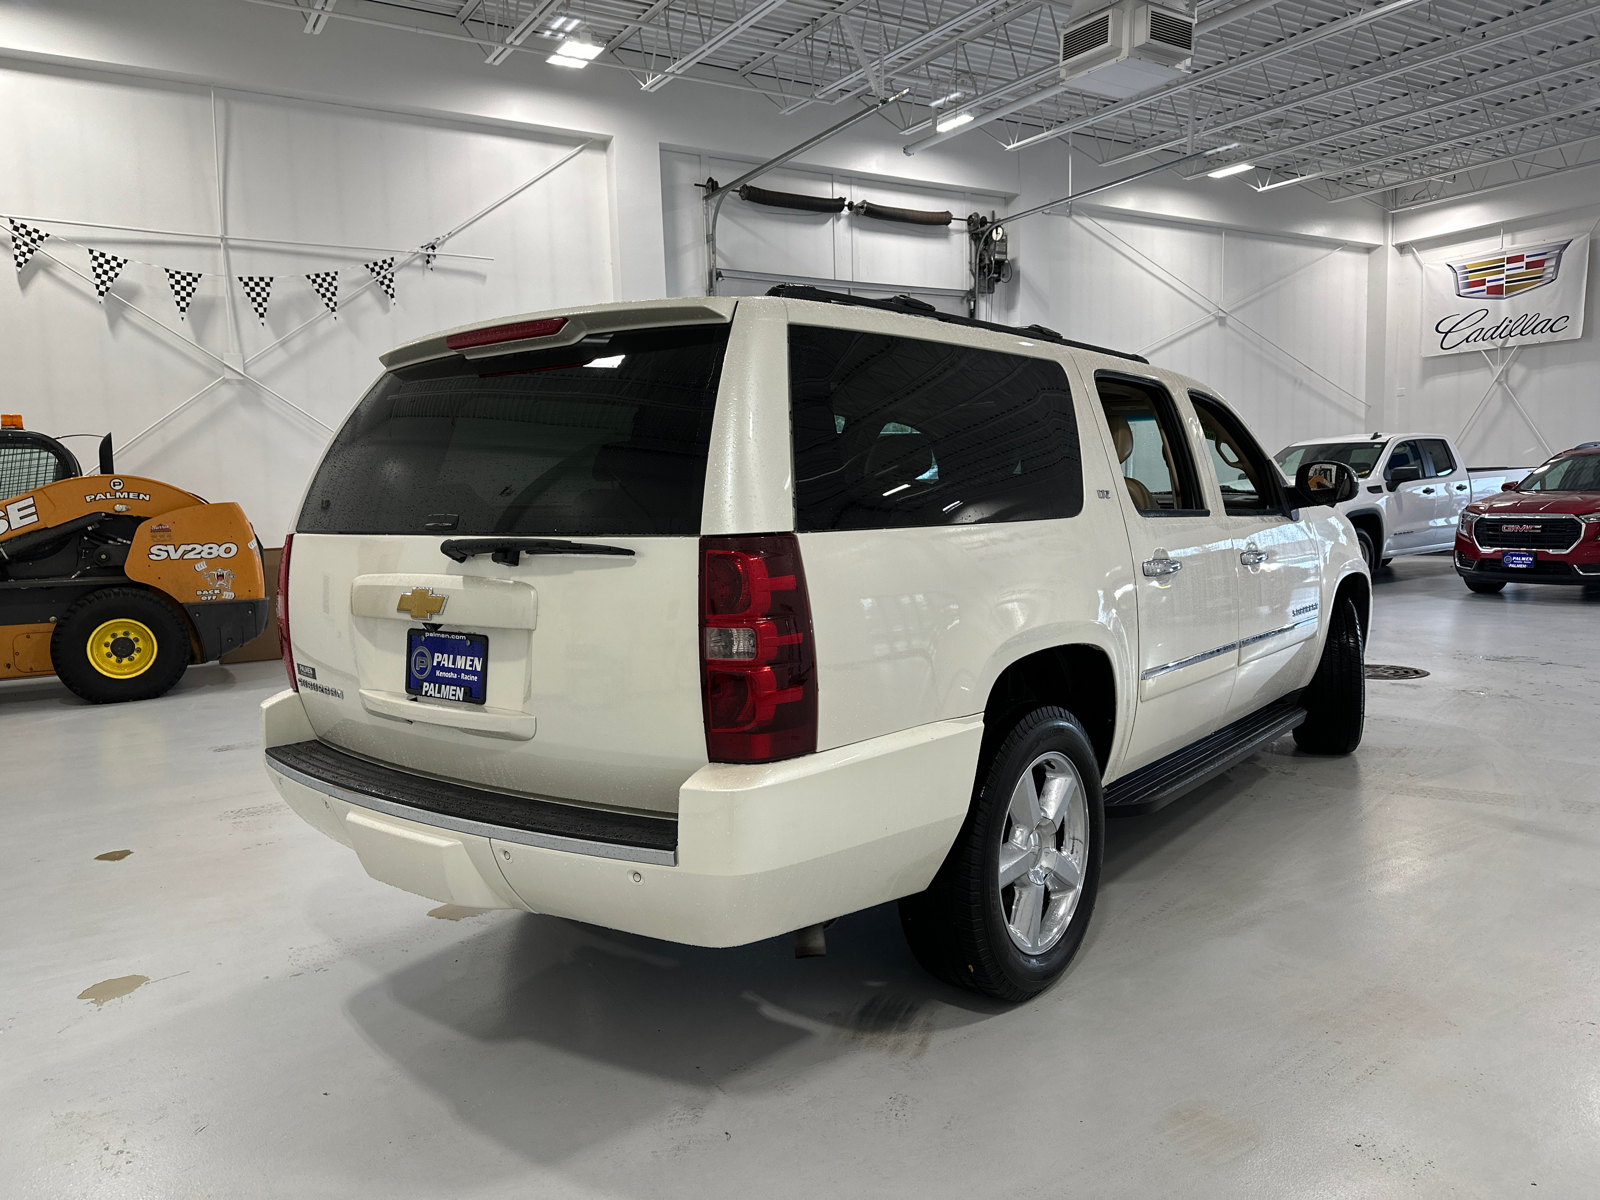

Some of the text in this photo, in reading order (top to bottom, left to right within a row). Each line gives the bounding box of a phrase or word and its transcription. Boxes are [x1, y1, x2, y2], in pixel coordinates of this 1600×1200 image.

[1435, 309, 1569, 350] Cadillac
[84, 491, 151, 503] PALMEN
[1502, 524, 1542, 532] GMC
[148, 542, 238, 561] SV280
[425, 632, 466, 640] palmen.com
[433, 652, 482, 671] PALMEN
[435, 670, 457, 679] Kenosha
[461, 673, 478, 681] Racine
[422, 682, 464, 701] PALMEN
